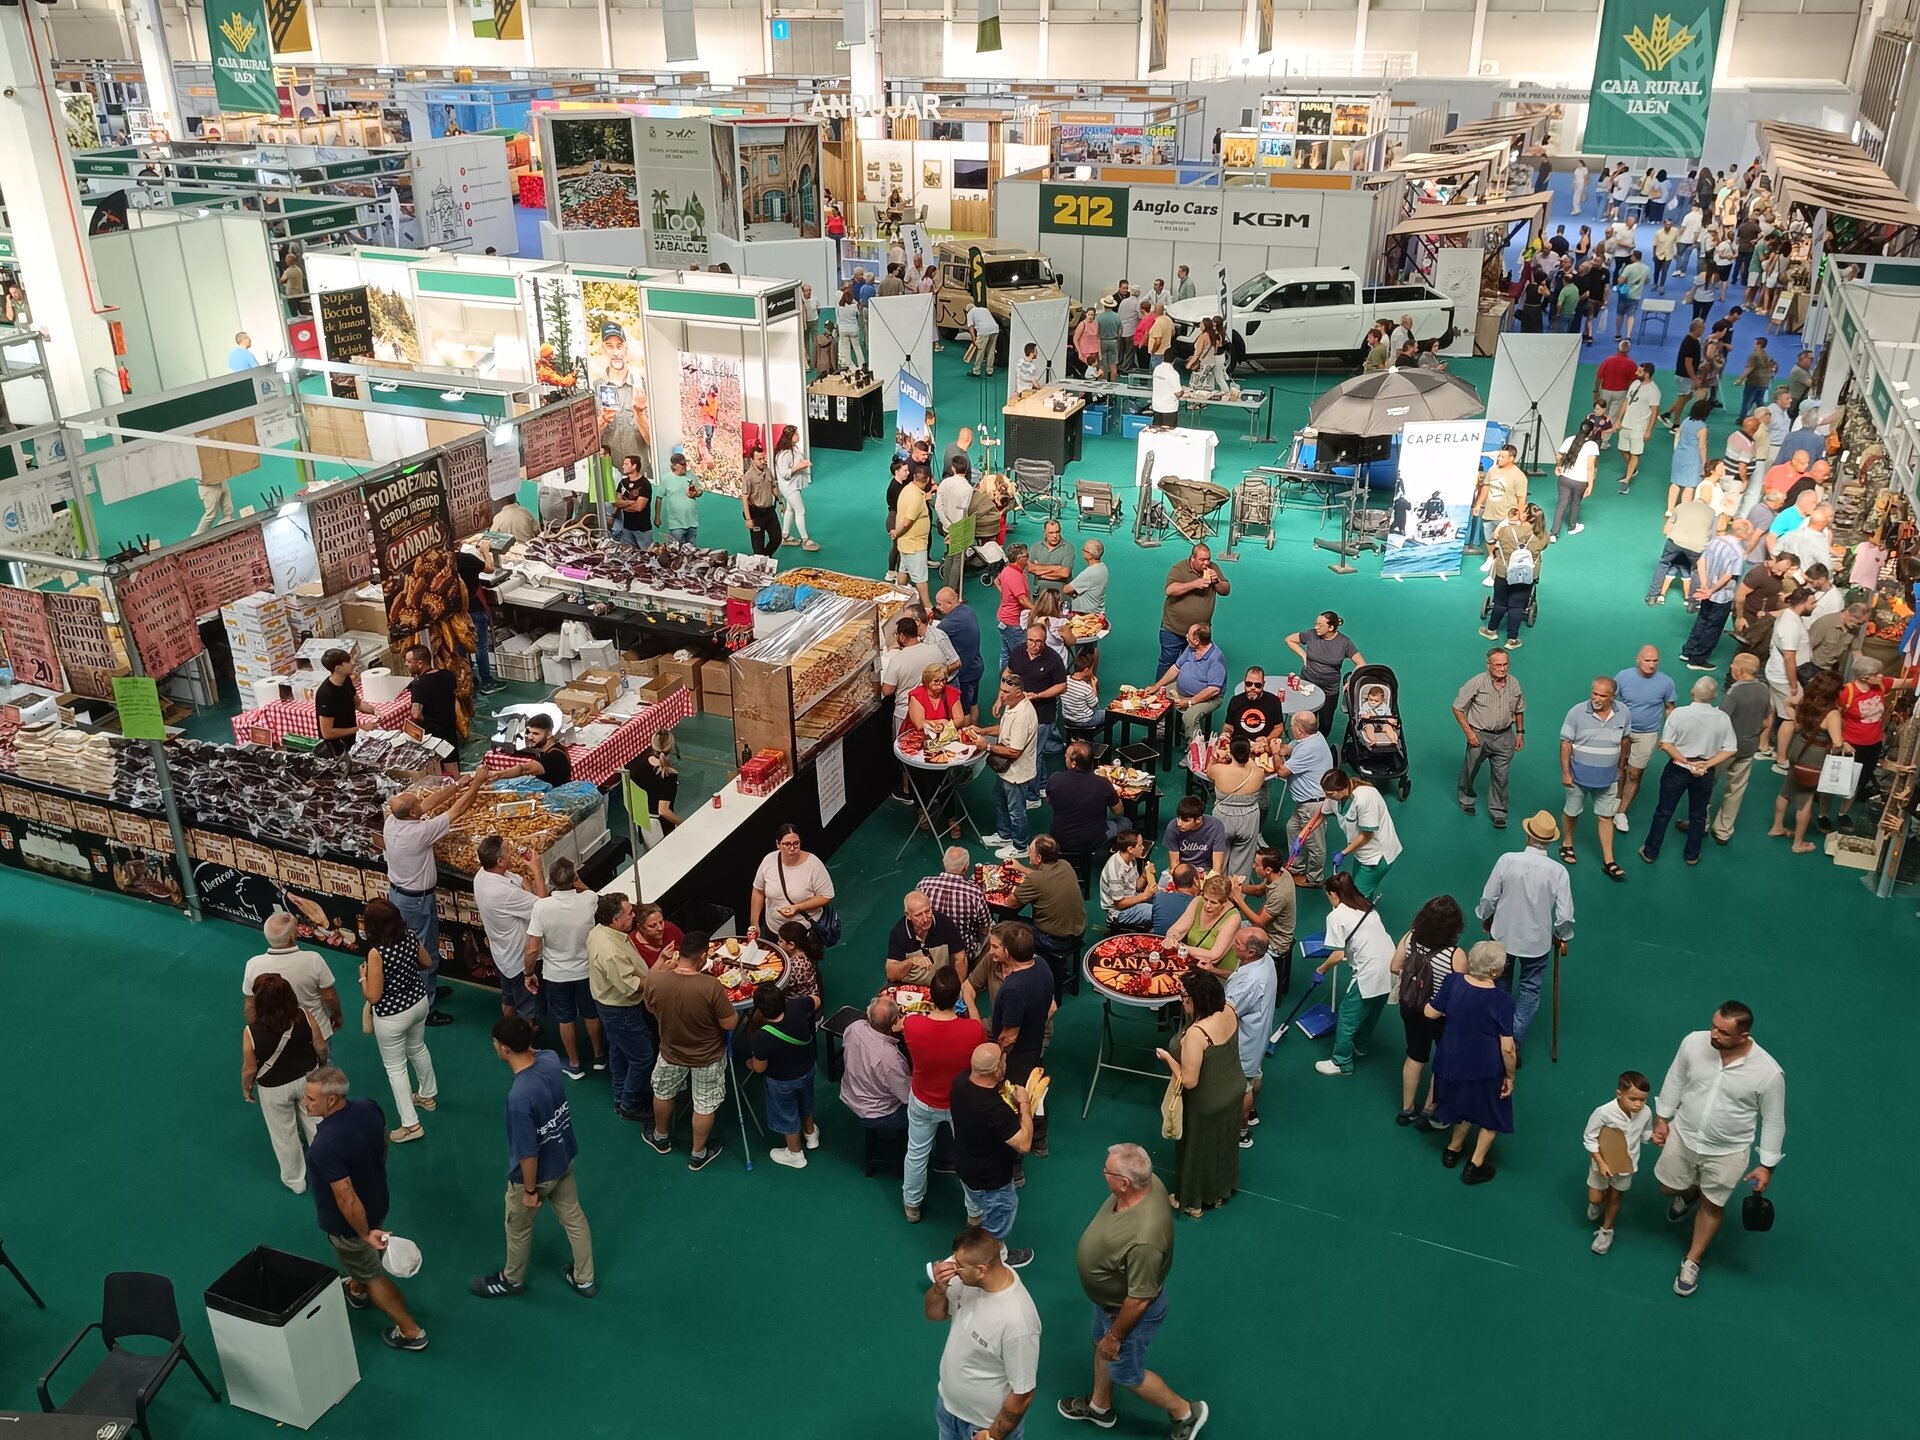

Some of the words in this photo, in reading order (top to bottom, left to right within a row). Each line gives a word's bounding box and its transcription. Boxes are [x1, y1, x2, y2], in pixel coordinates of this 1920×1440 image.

[778, 24, 784, 36] 1
[218, 57, 238, 68] CAJA
[240, 58, 270, 71] RURAL
[234, 71, 256, 84] JAÉN
[1600, 80, 1641, 95] CAJA
[1644, 81, 1703, 96] RURAL
[809, 93, 941, 120] ANDUJAR
[1300, 102, 1331, 112] RAPHAEL
[1626, 98, 1670, 114] JAÉN
[1054, 194, 1113, 227] 212
[1132, 200, 1180, 216] Anglo
[1183, 201, 1218, 216] Cars
[663, 214, 697, 232] 100
[1232, 212, 1310, 228] KGM
[654, 240, 708, 254] JABALCUZ
[323, 304, 363, 320] Bocata
[325, 322, 336, 332] de
[900, 380, 926, 408] CAPERLAN
[1407, 432, 1480, 444] CAPERLAN
[447, 443, 480, 464] Super
[448, 456, 484, 477] Bocata
[369, 470, 438, 514] TORREZNOS
[456, 490, 490, 511] Bebida
[315, 489, 358, 514] Super
[317, 504, 362, 528] Bocata
[380, 506, 409, 530] CERDO
[185, 551, 215, 568] Queso
[218, 535, 258, 556] Artesano
[328, 540, 370, 565] Bebida
[389, 521, 442, 570] CAÑADAS
[190, 565, 215, 578] Puro
[217, 558, 229, 569] de
[120, 563, 178, 598] Torreznos
[50, 594, 98, 614] Super
[132, 582, 178, 611] Artesanos
[138, 612, 150, 624] de
[152, 595, 180, 615] Cerdo
[52, 610, 104, 628] Bocata
[68, 652, 116, 670] Bebida
[30, 658, 54, 684] 20
[12, 802, 30, 814] GAMO
[80, 820, 109, 834] CABALLO
[120, 830, 147, 844] CIERVO
[161, 838, 176, 850] JAB
[206, 848, 224, 861] BUEY
[245, 859, 267, 873] CHIVO
[286, 869, 311, 884] CORZO
[330, 880, 352, 894] TORO
